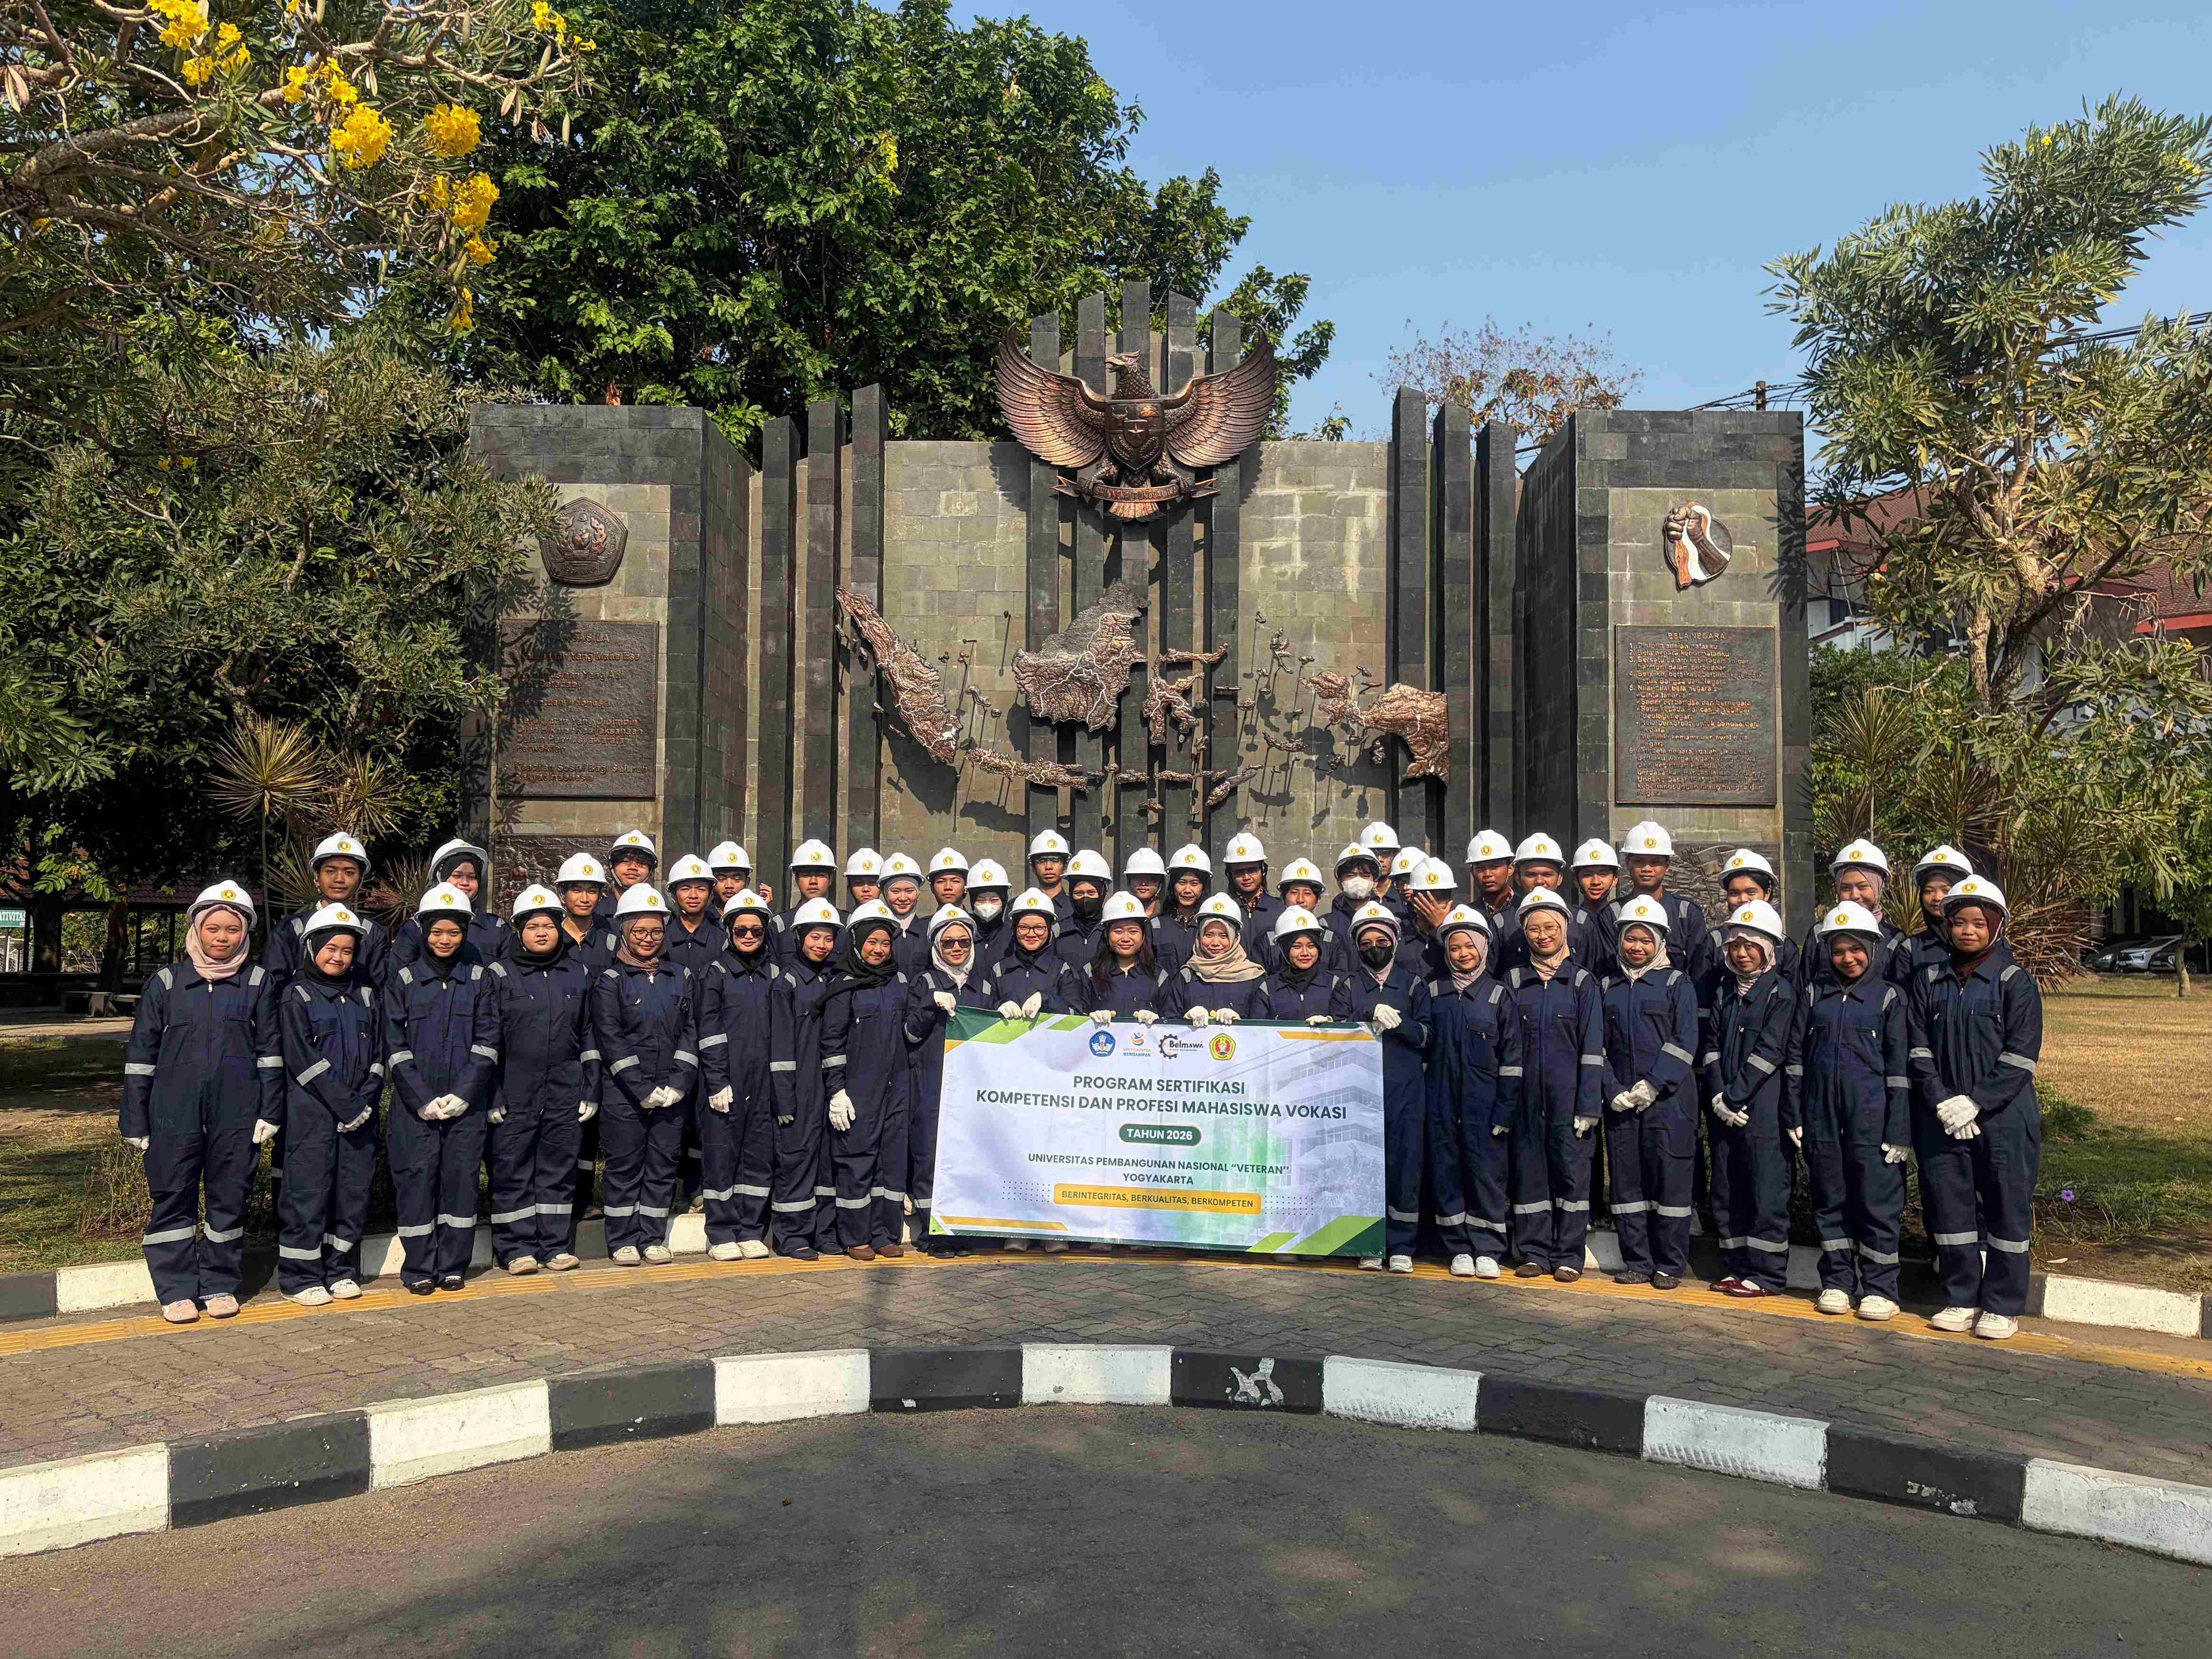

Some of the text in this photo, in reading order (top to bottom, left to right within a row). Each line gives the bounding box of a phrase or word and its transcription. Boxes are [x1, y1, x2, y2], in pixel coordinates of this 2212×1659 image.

[1074, 1076, 1245, 1094] PROGRAM SERTIFIKASI
[976, 1090, 1346, 1119] KOMPETENSI DAN PROFESI MAHASISWA VOKASI
[1127, 1128, 1192, 1140] TAHUN 2026
[1028, 1153, 1094, 1165] UNIVERSITAS
[1097, 1157, 1175, 1169] PEMBANGUNAN
[1178, 1161, 1228, 1172] NASIONAL
[1123, 1173, 1193, 1185] YOGYAKARTA
[1062, 1190, 1253, 1208] BERINTEGRITAS, BERKUALITAS, BERKOMPETEN
